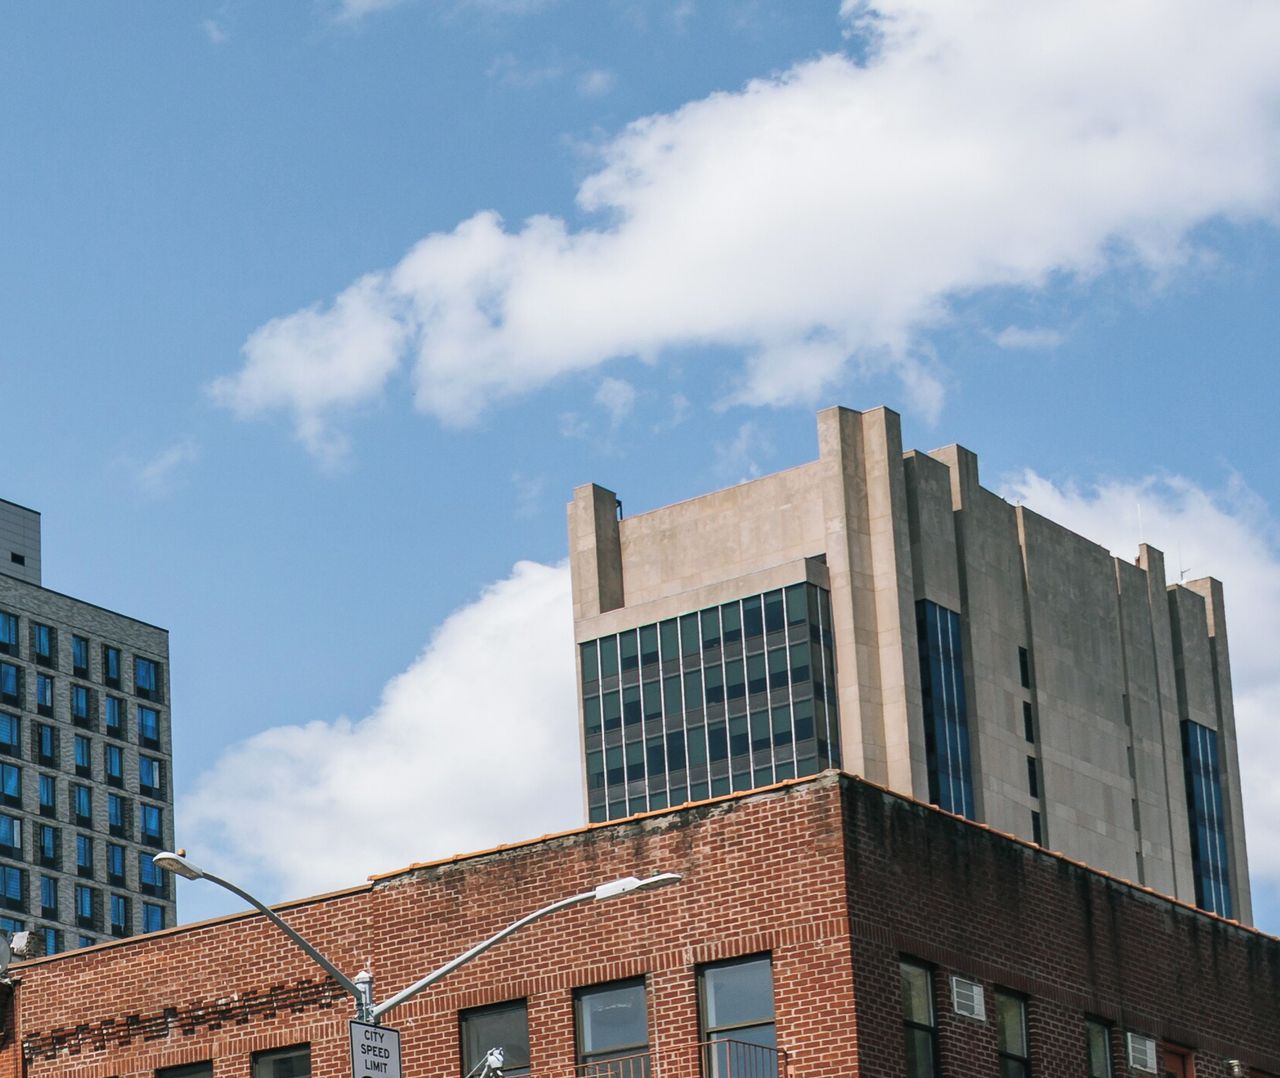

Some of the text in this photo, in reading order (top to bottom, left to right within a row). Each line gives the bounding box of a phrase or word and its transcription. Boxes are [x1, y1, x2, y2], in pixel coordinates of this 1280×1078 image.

[364, 1029, 385, 1044] CITY
[360, 1043, 390, 1060] SPEED
[364, 1059, 388, 1074] LIMIT
